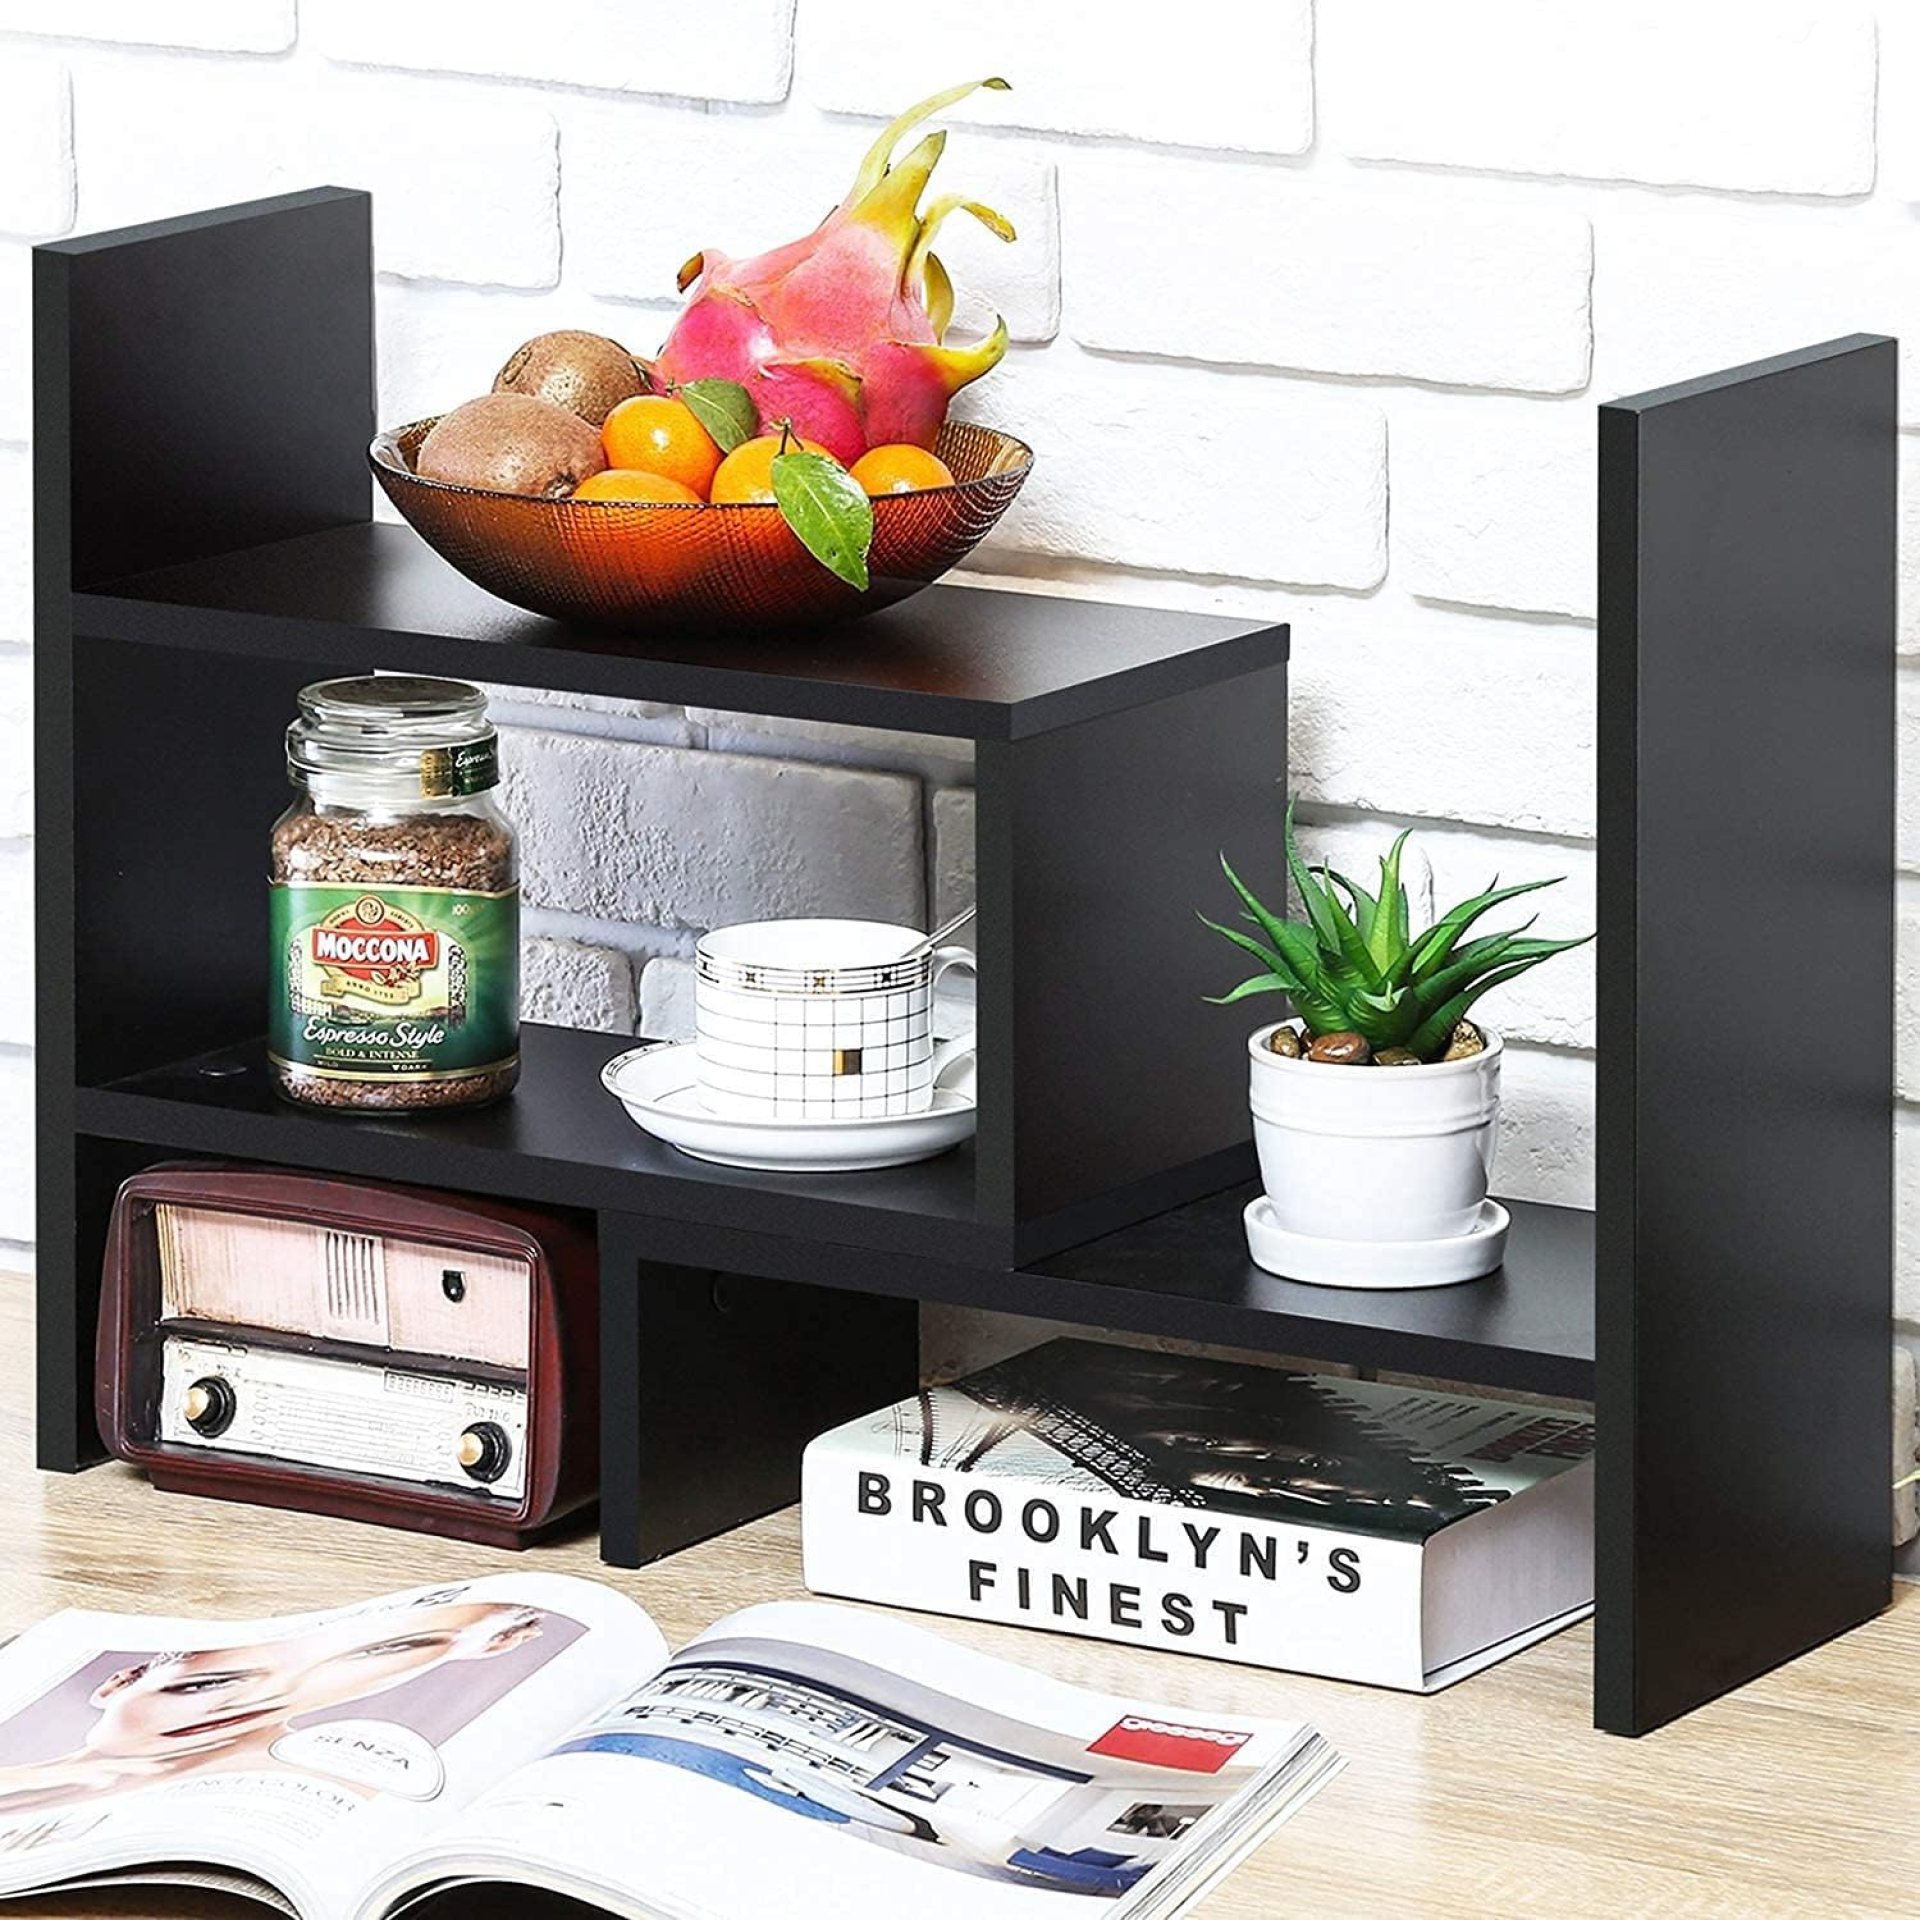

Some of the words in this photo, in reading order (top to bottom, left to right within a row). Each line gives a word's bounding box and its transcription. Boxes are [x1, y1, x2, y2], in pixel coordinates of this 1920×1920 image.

[317, 931, 430, 963] MOCCONA
[303, 1015, 390, 1046] Espresso
[389, 1022, 445, 1049] Style
[369, 1049, 420, 1060] INTENSE
[857, 1470, 1363, 1594] BROOKLYN’S
[968, 1558, 1249, 1645] FINEST
